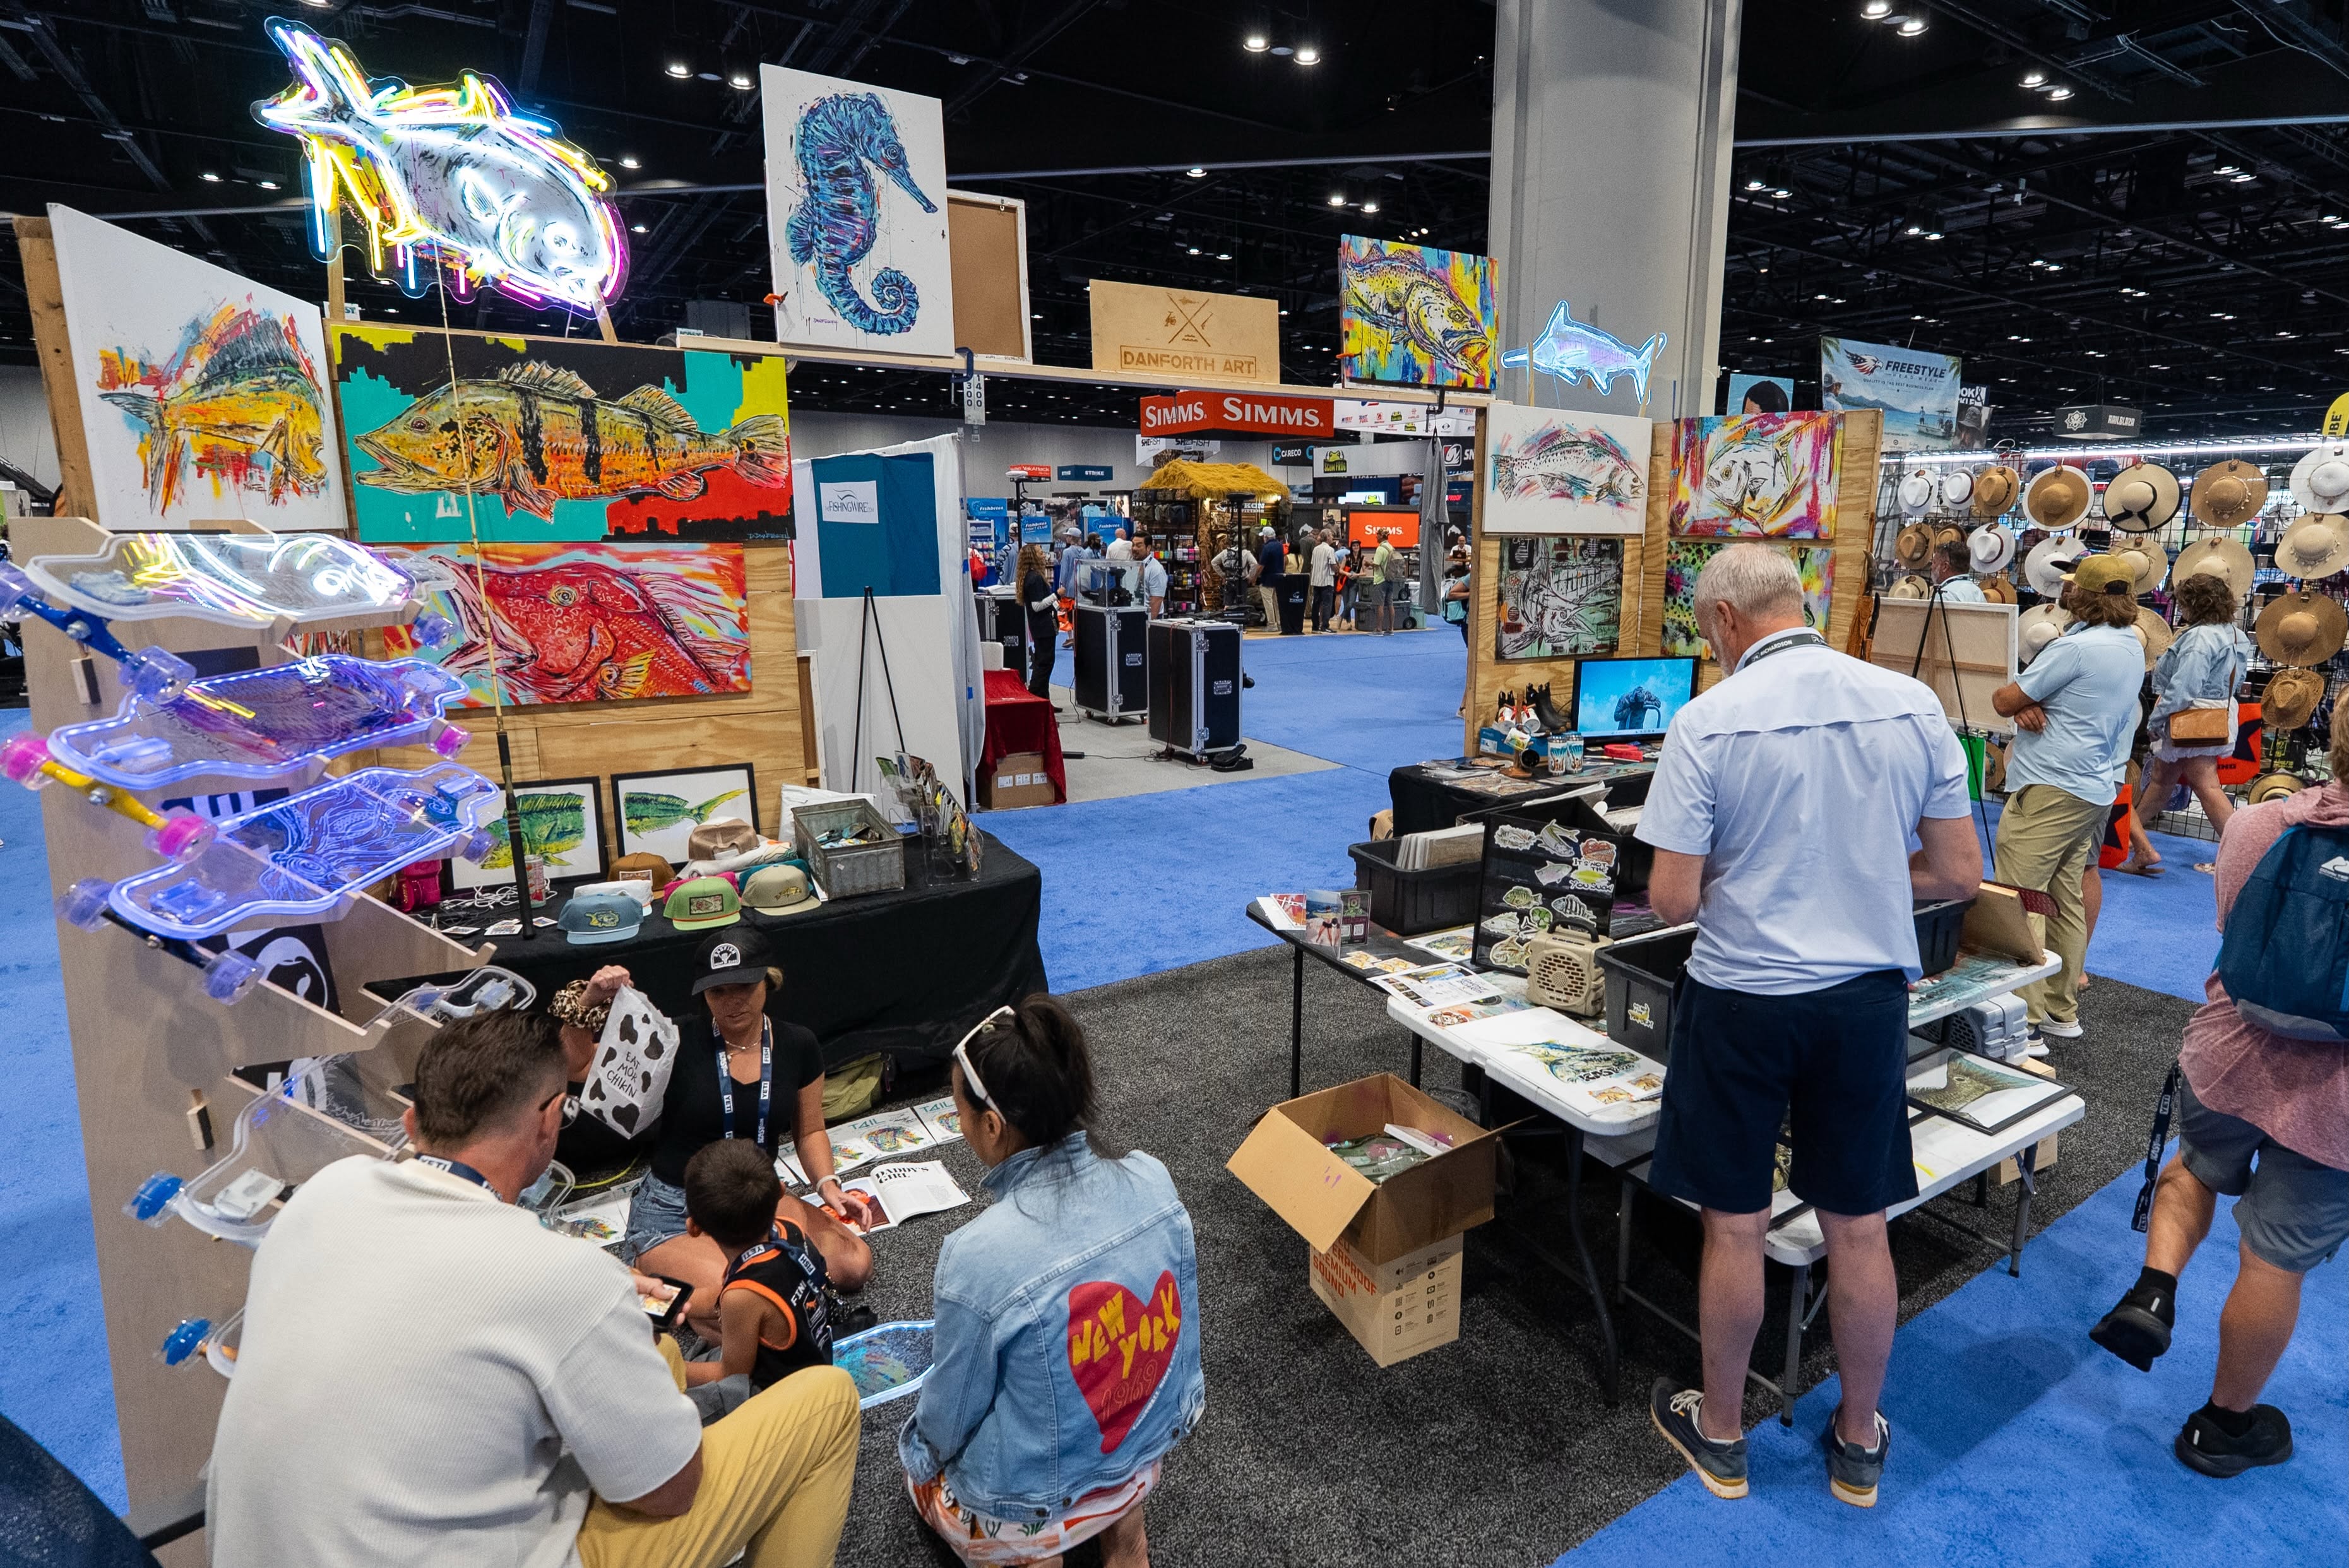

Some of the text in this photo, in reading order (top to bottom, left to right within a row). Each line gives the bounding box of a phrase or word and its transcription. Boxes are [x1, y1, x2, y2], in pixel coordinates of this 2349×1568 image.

[1123, 351, 1254, 374] DANFORTH ART
[1885, 360, 1947, 379] FREESTYLE
[1959, 387, 1976, 398] OK
[1145, 401, 1205, 428] SIMMS
[1222, 396, 1321, 427] SIMMS
[2107, 414, 2136, 427] RAILBLAZA
[1364, 525, 1403, 535] SIMS
[1759, 639, 1793, 656] RICHARDSON
[626, 1051, 641, 1070] EAT
[617, 1063, 638, 1083] MOR
[607, 1070, 638, 1098] CHIKIN
[2161, 1095, 2171, 1114] YETI
[850, 1117, 886, 1131] TAIL
[875, 1167, 929, 1179] DADDY'S
[879, 1173, 911, 1184] GIRL
[742, 1245, 764, 1261] YETI
[799, 1256, 814, 1274] FISH
[1321, 1252, 1357, 1295] EMIUM
[1331, 1242, 1377, 1296] ERPROOF
[1313, 1254, 1344, 1298] SOUND
[1072, 1281, 1181, 1380] NEW YORK
